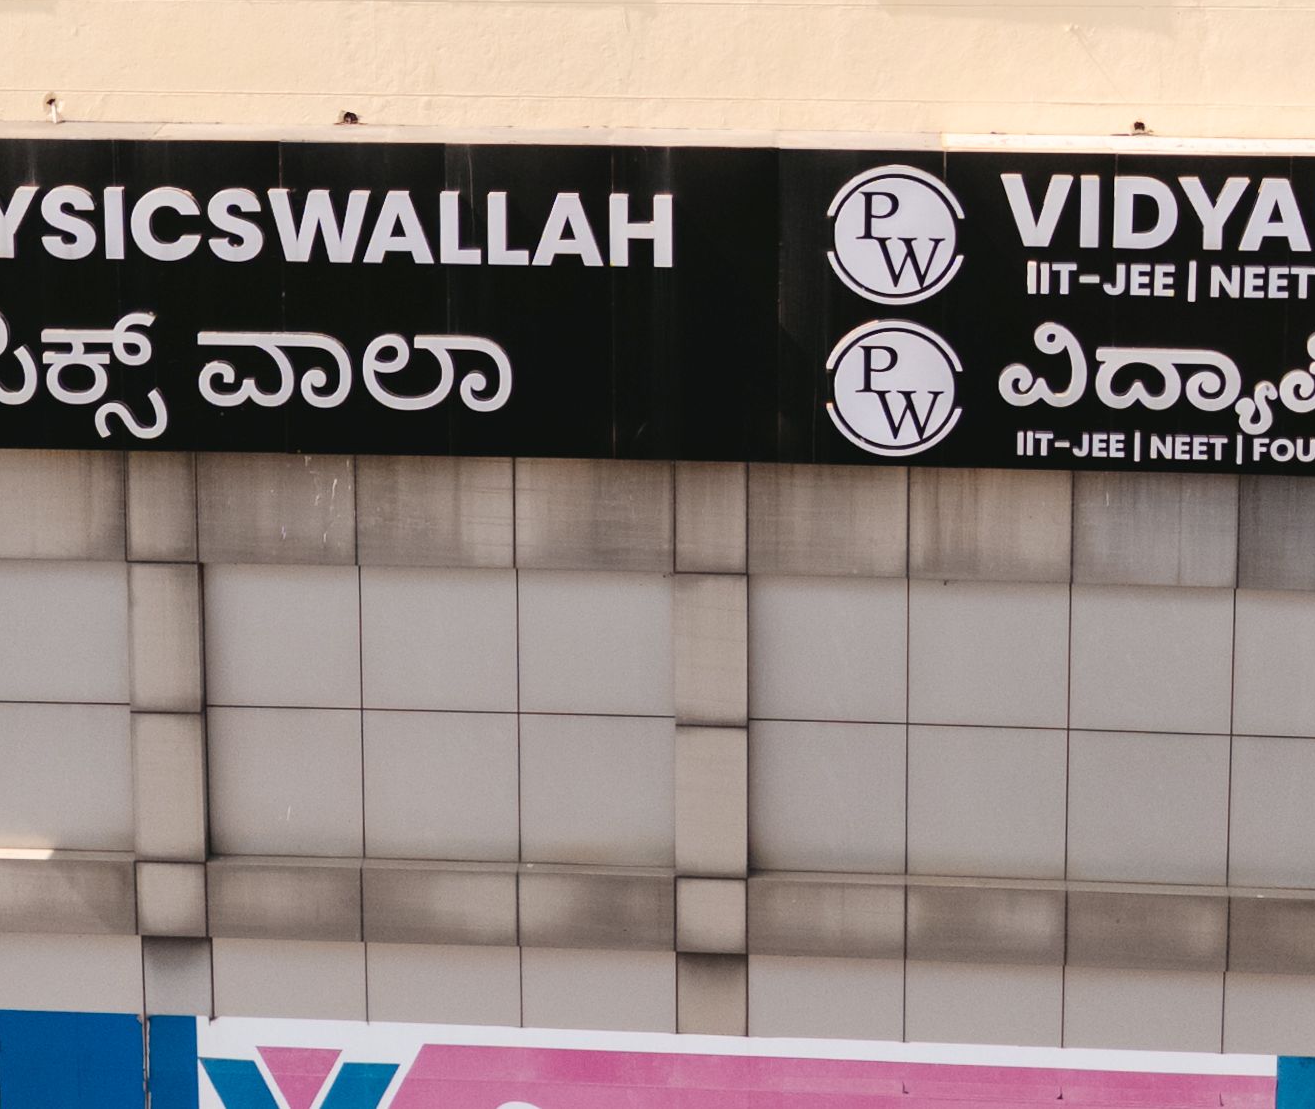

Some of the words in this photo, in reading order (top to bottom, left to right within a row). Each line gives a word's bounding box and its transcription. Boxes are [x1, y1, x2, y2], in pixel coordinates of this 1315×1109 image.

[1026, 260, 1176, 297] IIT-JEE
[197, 331, 513, 412] ವಾಲಾ
[1016, 431, 1125, 458] IIT-JEE
[1149, 435, 1229, 461] NEET
